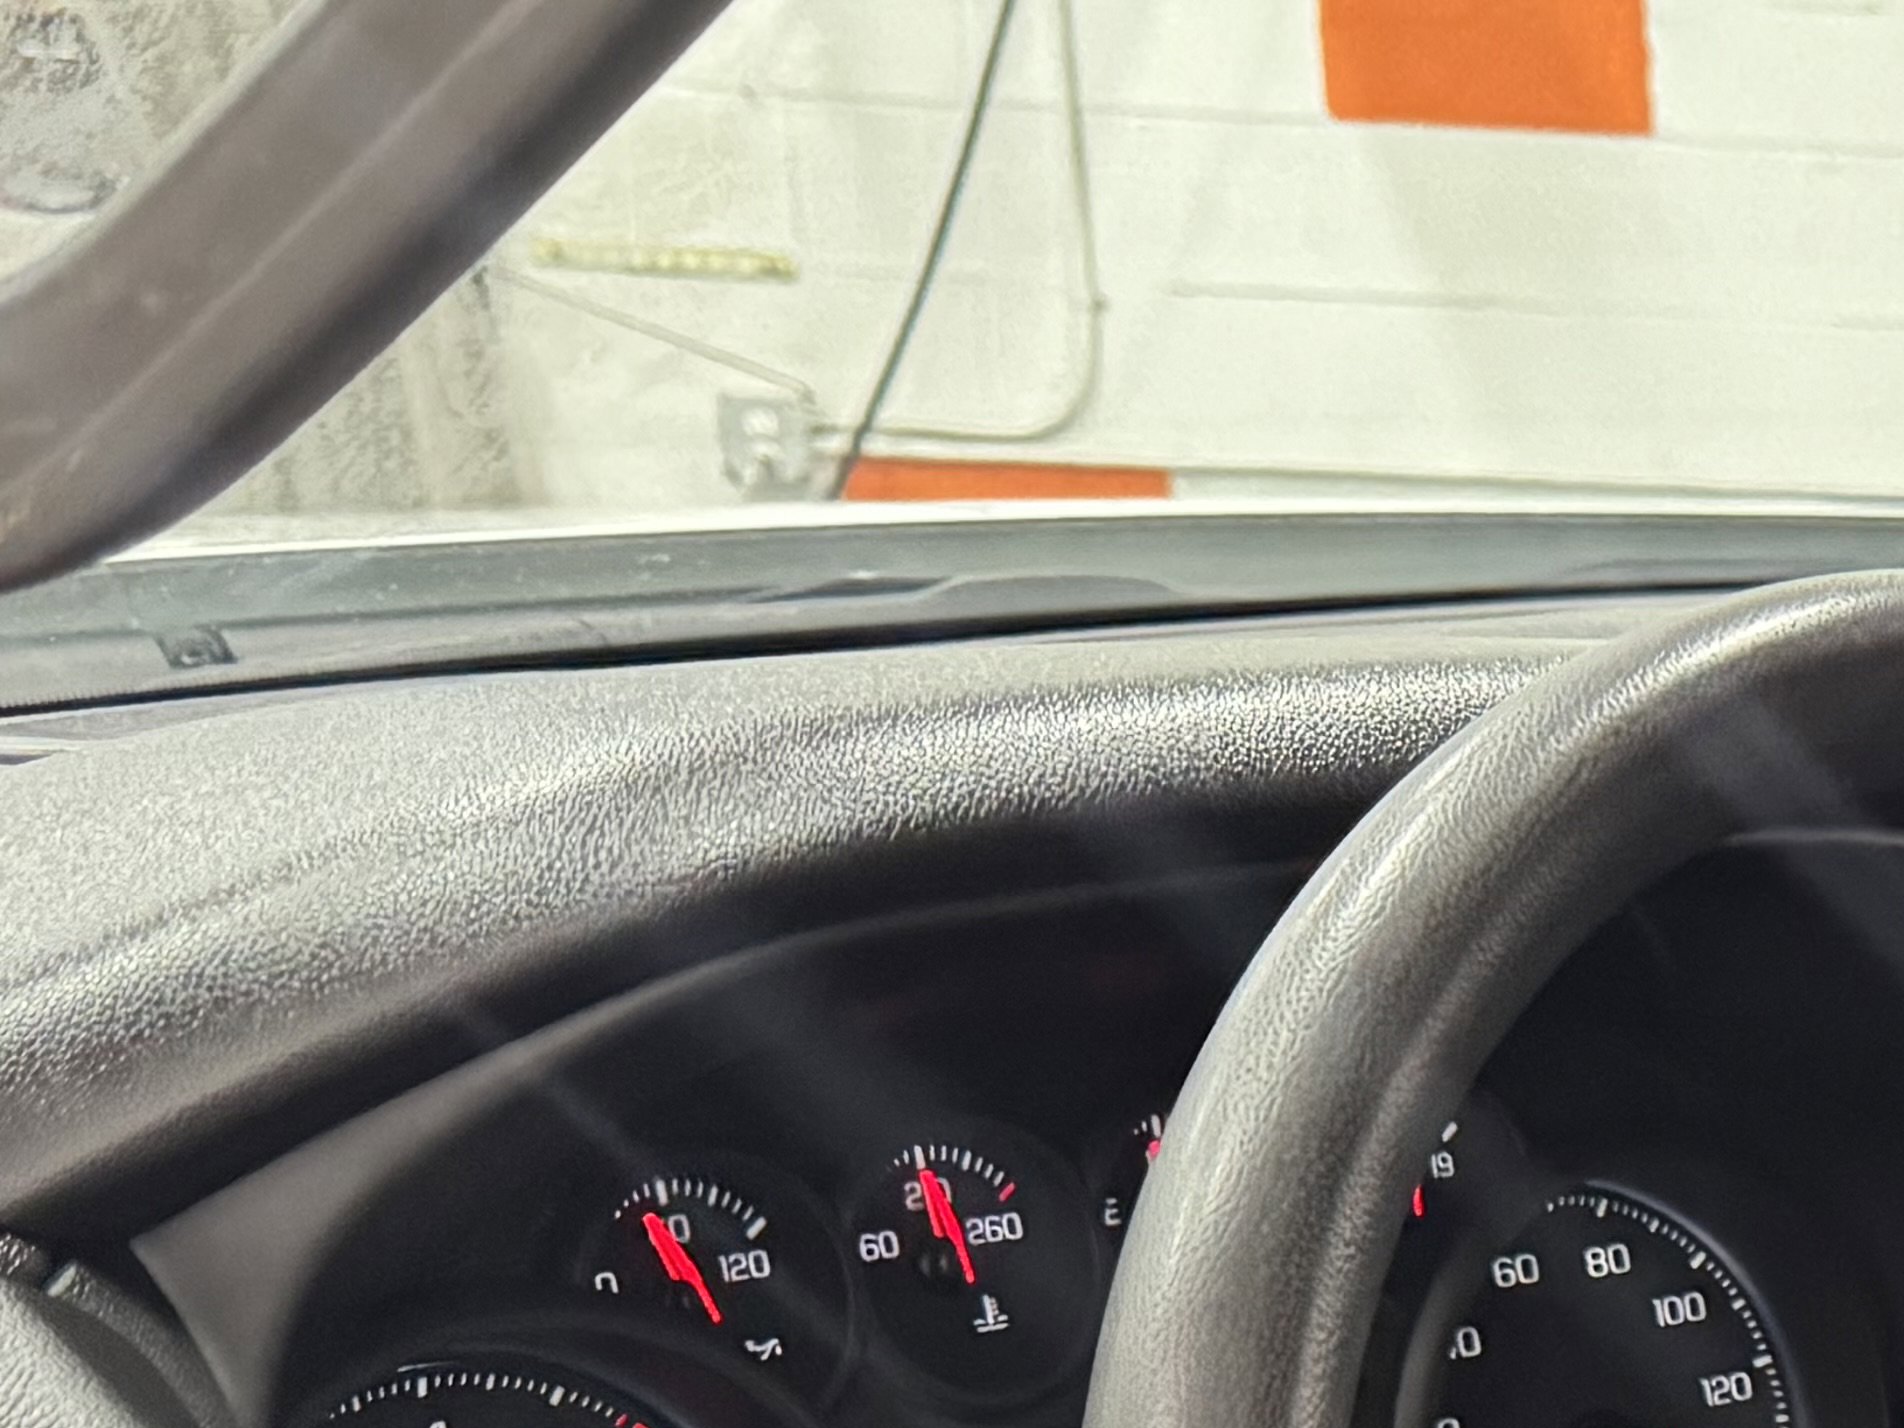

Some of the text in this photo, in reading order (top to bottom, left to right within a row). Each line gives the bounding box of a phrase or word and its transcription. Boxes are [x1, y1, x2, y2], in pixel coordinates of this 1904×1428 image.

[965, 1211, 1024, 1246] 260
[717, 1249, 771, 1283] 120
[1492, 1253, 1541, 1288] 60
[1583, 1243, 1632, 1279] 80
[1652, 1291, 1707, 1328] 100
[1701, 1371, 1753, 1408] 120
